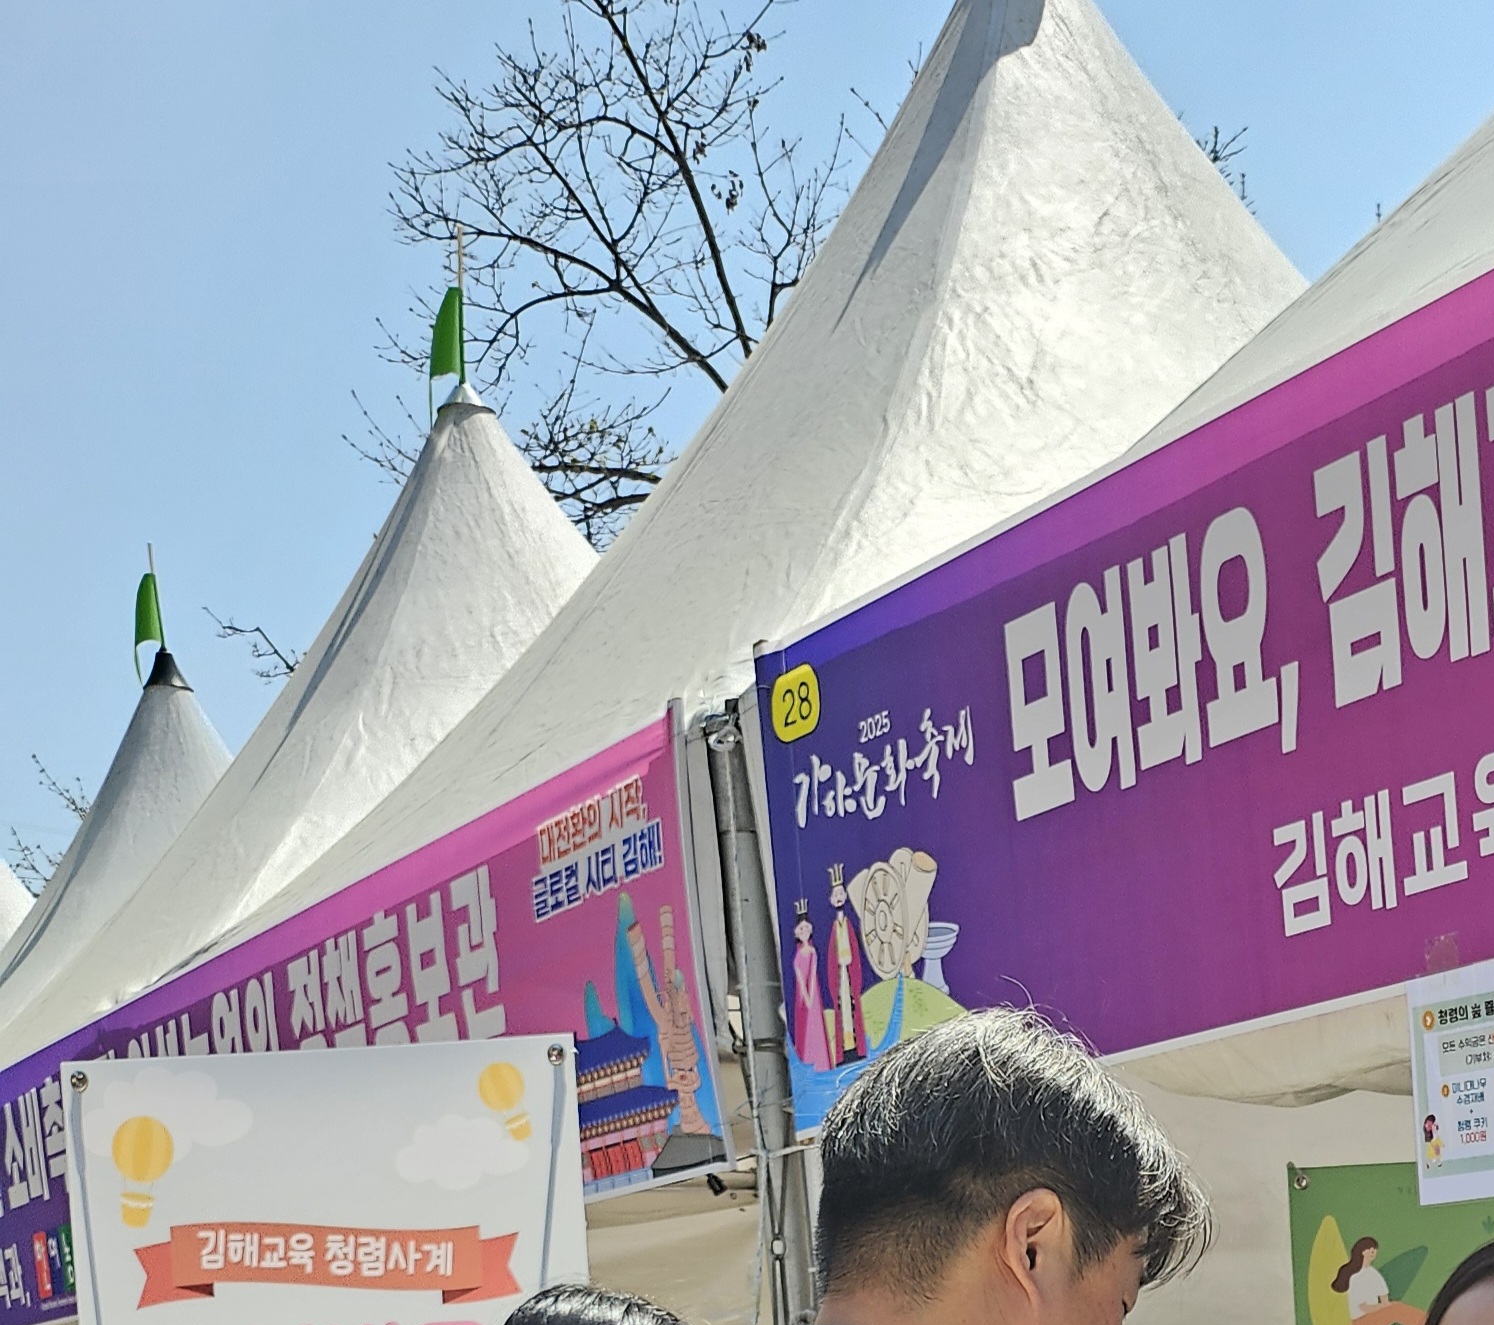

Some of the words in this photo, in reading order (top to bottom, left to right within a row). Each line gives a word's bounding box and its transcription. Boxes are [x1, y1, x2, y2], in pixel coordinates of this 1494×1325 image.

[1003, 504, 1300, 822] 모여봐요,
[782, 681, 812, 728] 28
[858, 710, 891, 743] 2025
[538, 799, 603, 866] 대전환의
[608, 777, 647, 830] 시작,
[534, 861, 582, 920] 글로컬
[586, 843, 618, 893] 시티
[622, 820, 663, 879] 김해!
[1437, 1004, 1469, 1026] 청렴의
[1471, 1002, 1482, 1019] 숲
[1441, 1040, 1456, 1053] 모든
[196, 1229, 316, 1271] 김해교육
[325, 1233, 454, 1278] 청렴사계
